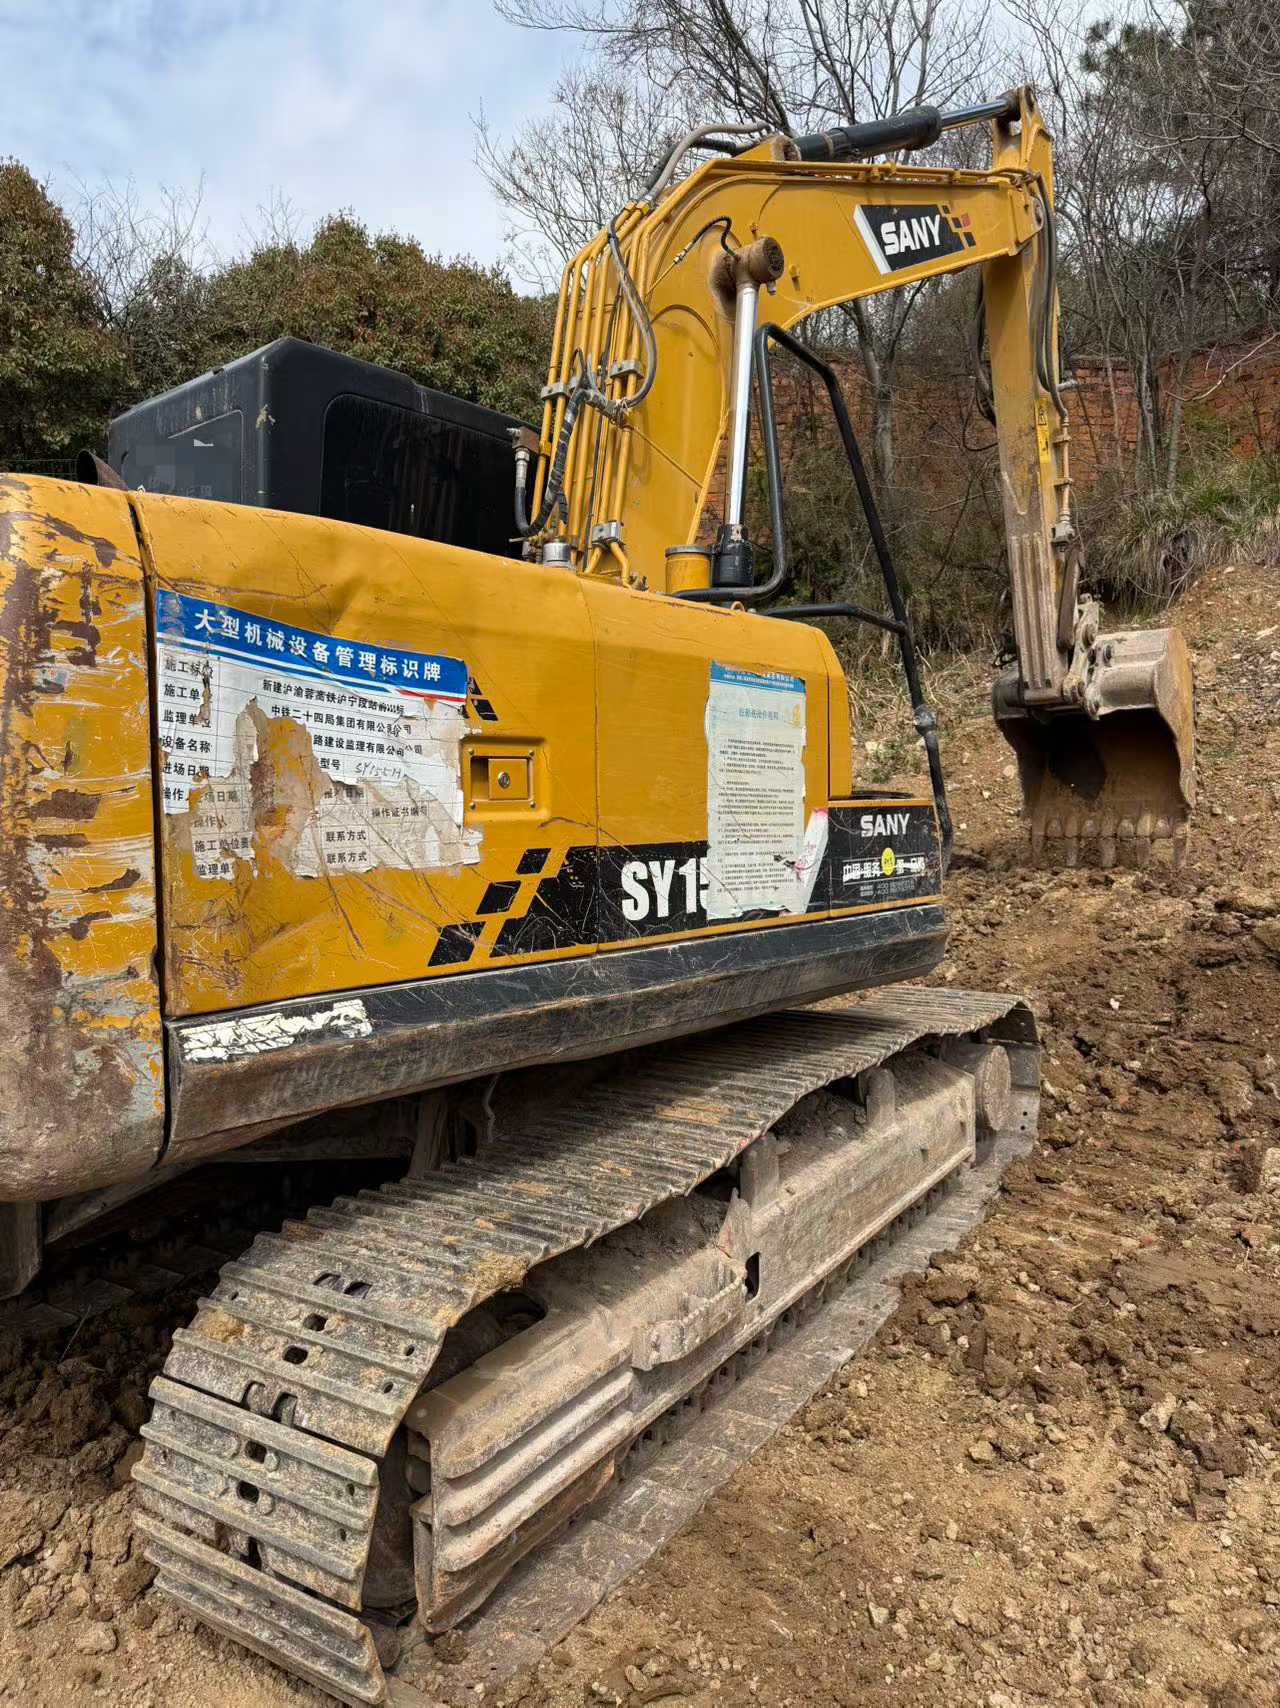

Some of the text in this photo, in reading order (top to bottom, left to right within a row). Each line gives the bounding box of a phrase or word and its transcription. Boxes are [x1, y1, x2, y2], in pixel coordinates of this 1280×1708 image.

[881, 214, 941, 256] SANY
[194, 608, 442, 682] 大型机械设备管理标识牌
[159, 735, 212, 754] 设备名称
[860, 813, 910, 838] SANY
